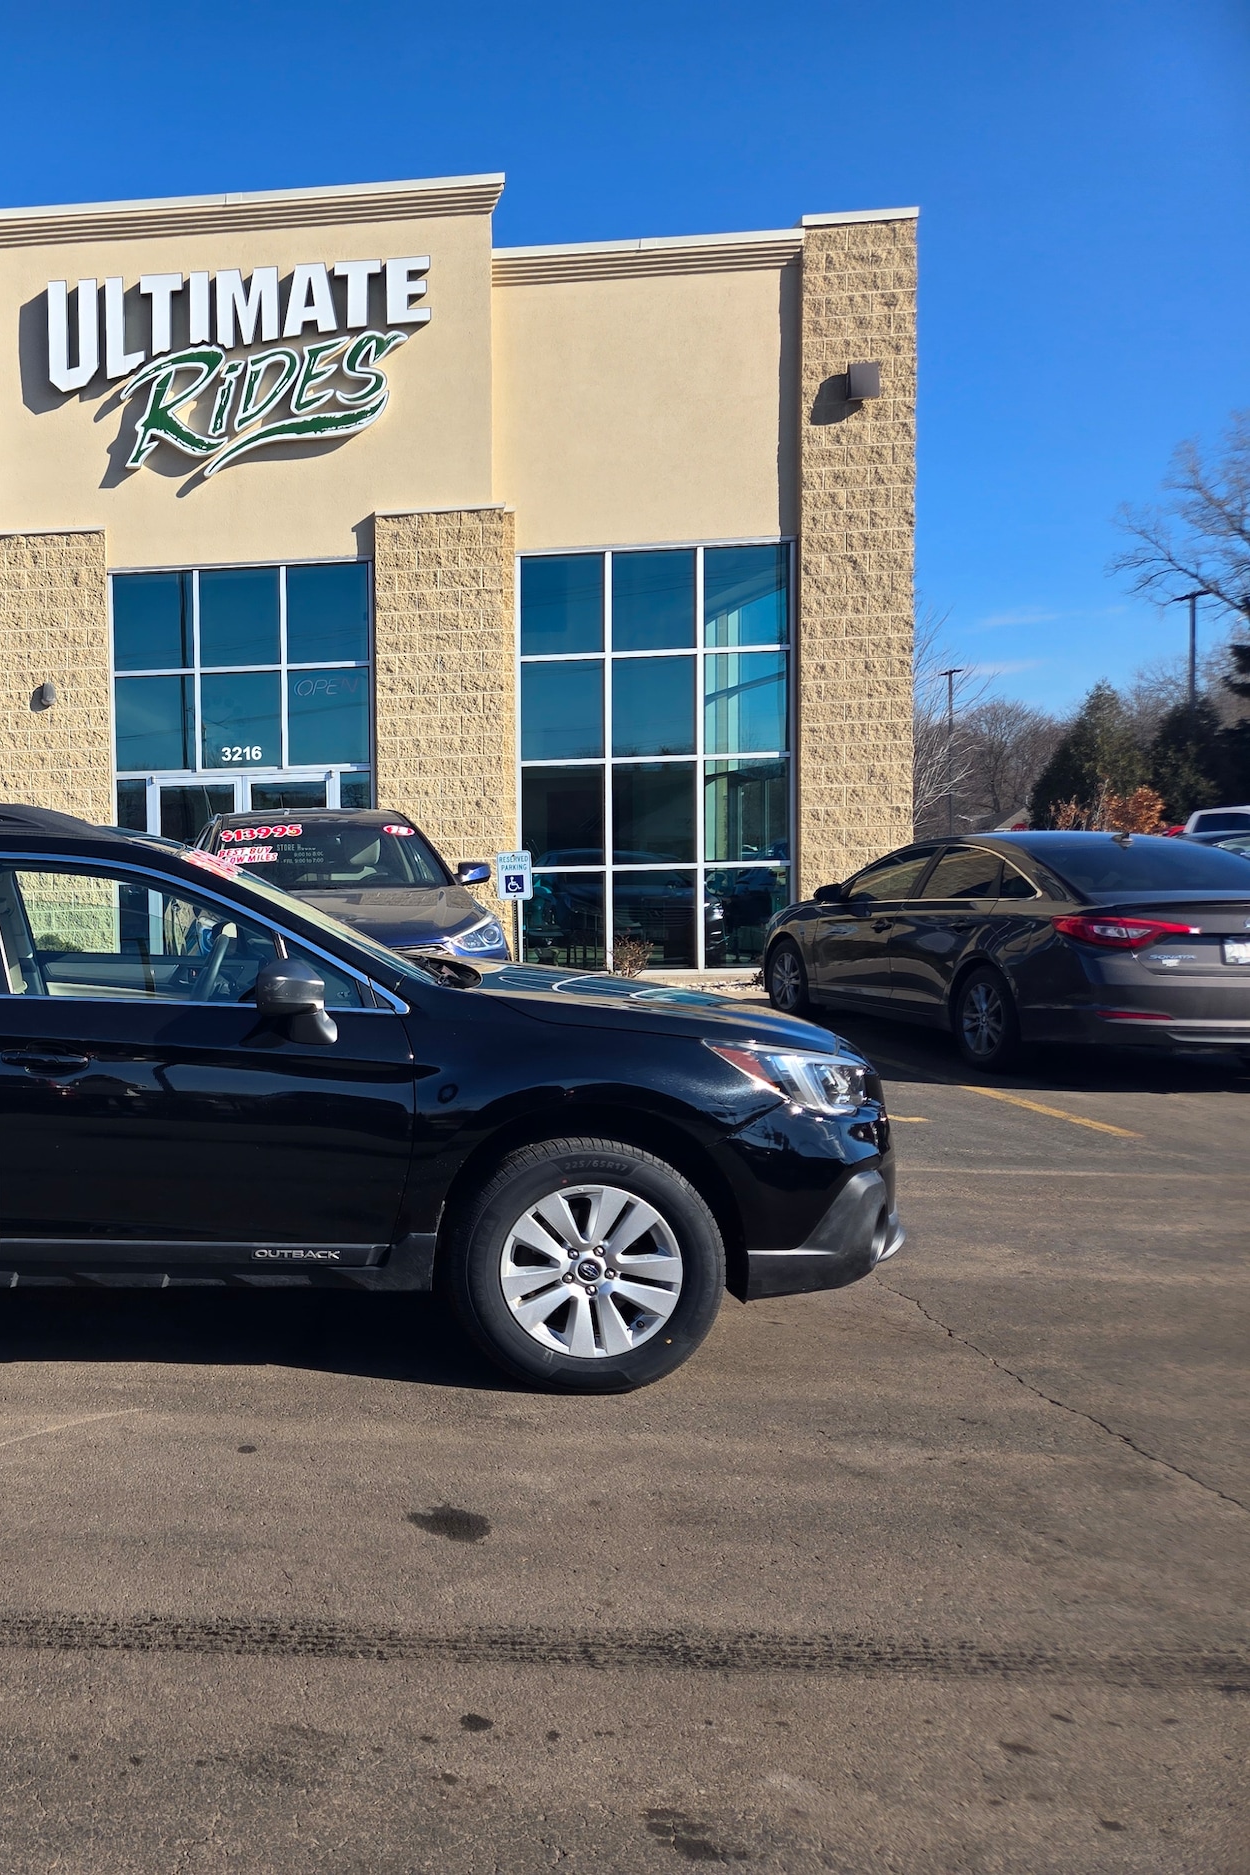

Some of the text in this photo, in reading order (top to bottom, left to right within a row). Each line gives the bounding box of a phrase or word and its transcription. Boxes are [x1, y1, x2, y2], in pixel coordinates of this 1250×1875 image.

[47, 255, 432, 393] ULTIMATE
[293, 678, 358, 697] OPEN
[221, 746, 262, 762] 3216
[220, 824, 302, 843] $13995
[218, 846, 272, 858] BEST BUY
[247, 852, 277, 863] MILES
[564, 1159, 629, 1172] 225/65R17
[254, 1249, 340, 1260] OUTBACK
